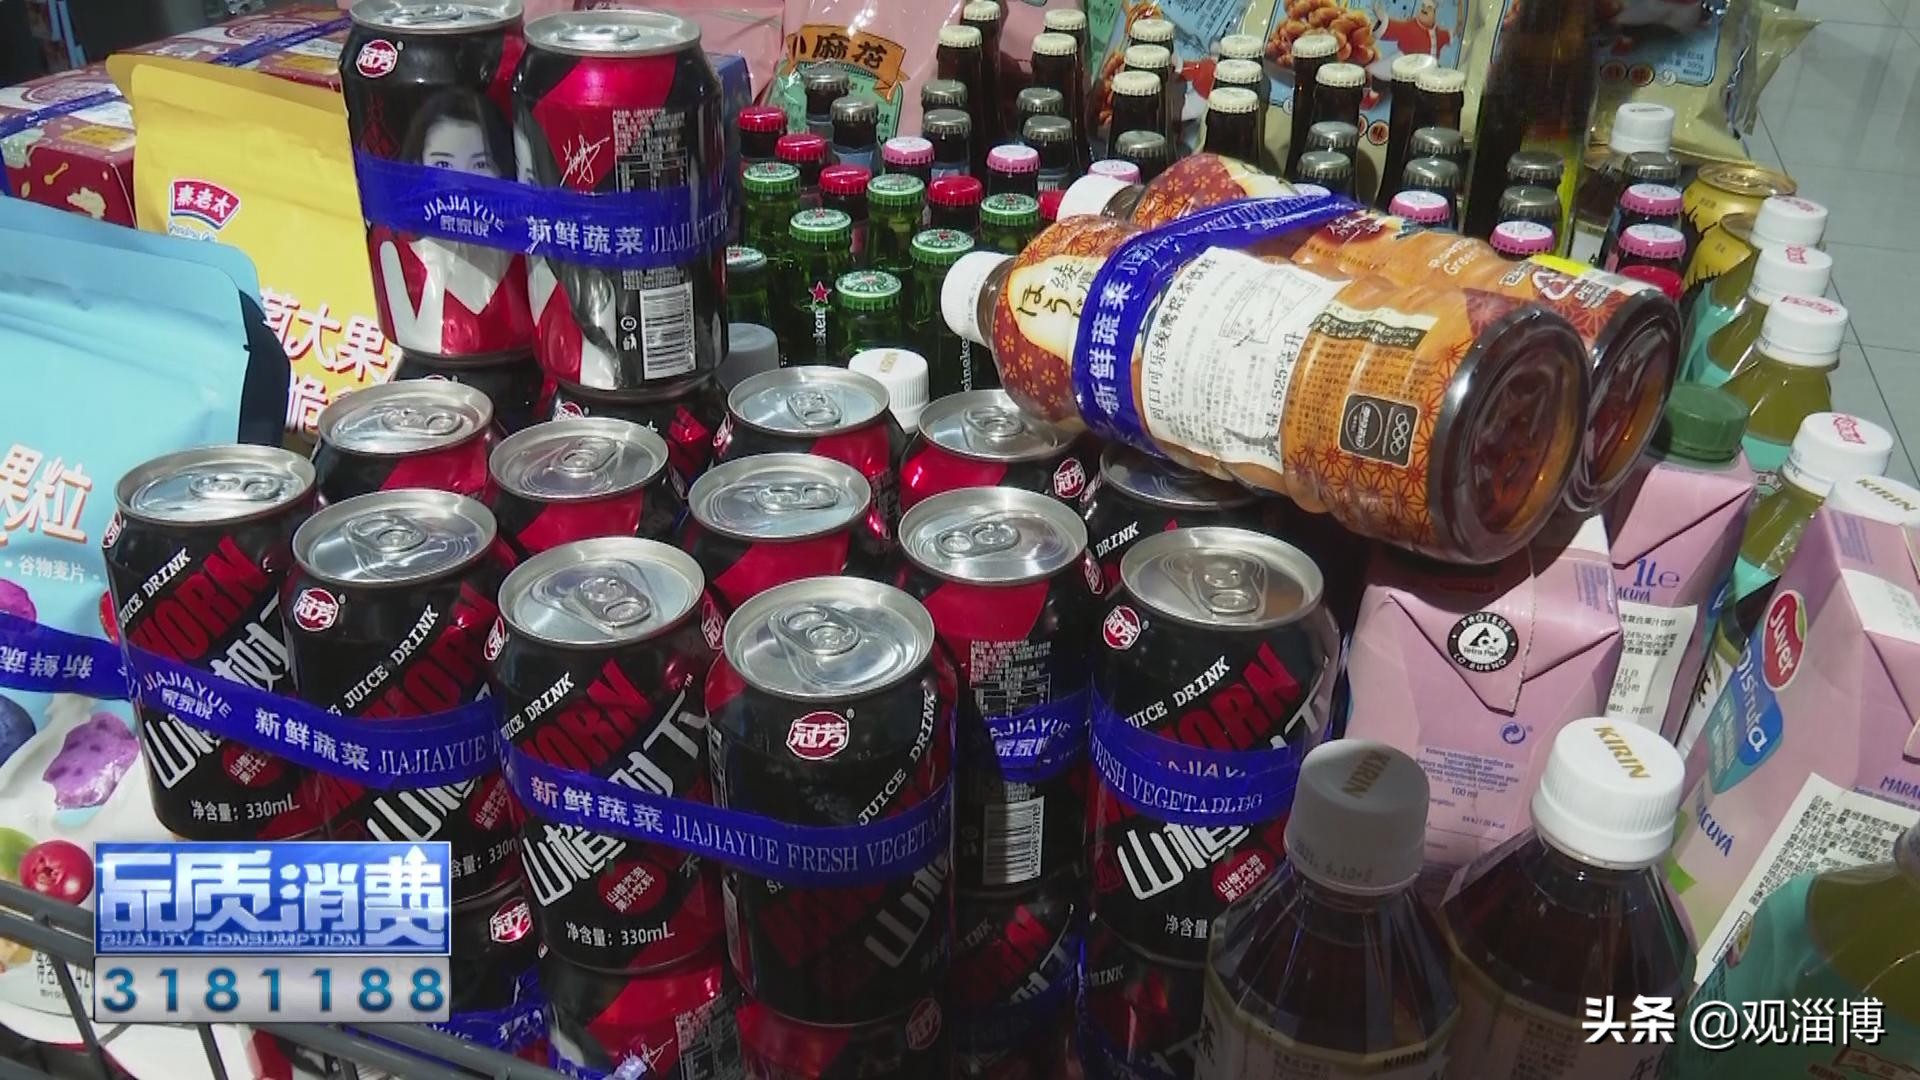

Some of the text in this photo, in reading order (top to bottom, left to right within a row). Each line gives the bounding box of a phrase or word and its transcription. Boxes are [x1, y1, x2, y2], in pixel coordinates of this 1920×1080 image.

[423, 195, 505, 233] JIAJIAYUE
[525, 214, 644, 254] 新鲜蔬菜
[1088, 279, 1133, 418] 新鲜蔬菜
[1856, 478, 1918, 512] KIRIN
[1095, 521, 1140, 559] DRINK
[142, 547, 192, 599] DRINK
[343, 603, 440, 711] JUICE DRINK
[1172, 654, 1231, 709] DRINK
[144, 670, 234, 720] JIAJIAYUE
[524, 671, 576, 727] DRINK
[254, 707, 487, 775] 新鲜蔬菜 JIAJIAYUE
[790, 722, 848, 749] 冠芳
[857, 767, 907, 827] JUICE
[909, 690, 937, 763] DRINK
[1594, 726, 1651, 780] KIRIN
[1342, 750, 1393, 800] KIRIN
[246, 792, 300, 820] 330mL
[530, 775, 665, 834] 新鲜蔬菜
[672, 814, 780, 867] JIAJIAYUE
[786, 841, 859, 874] FRESH
[566, 921, 676, 947] 净含量： 330mL
[1164, 912, 1208, 940] 净含量
